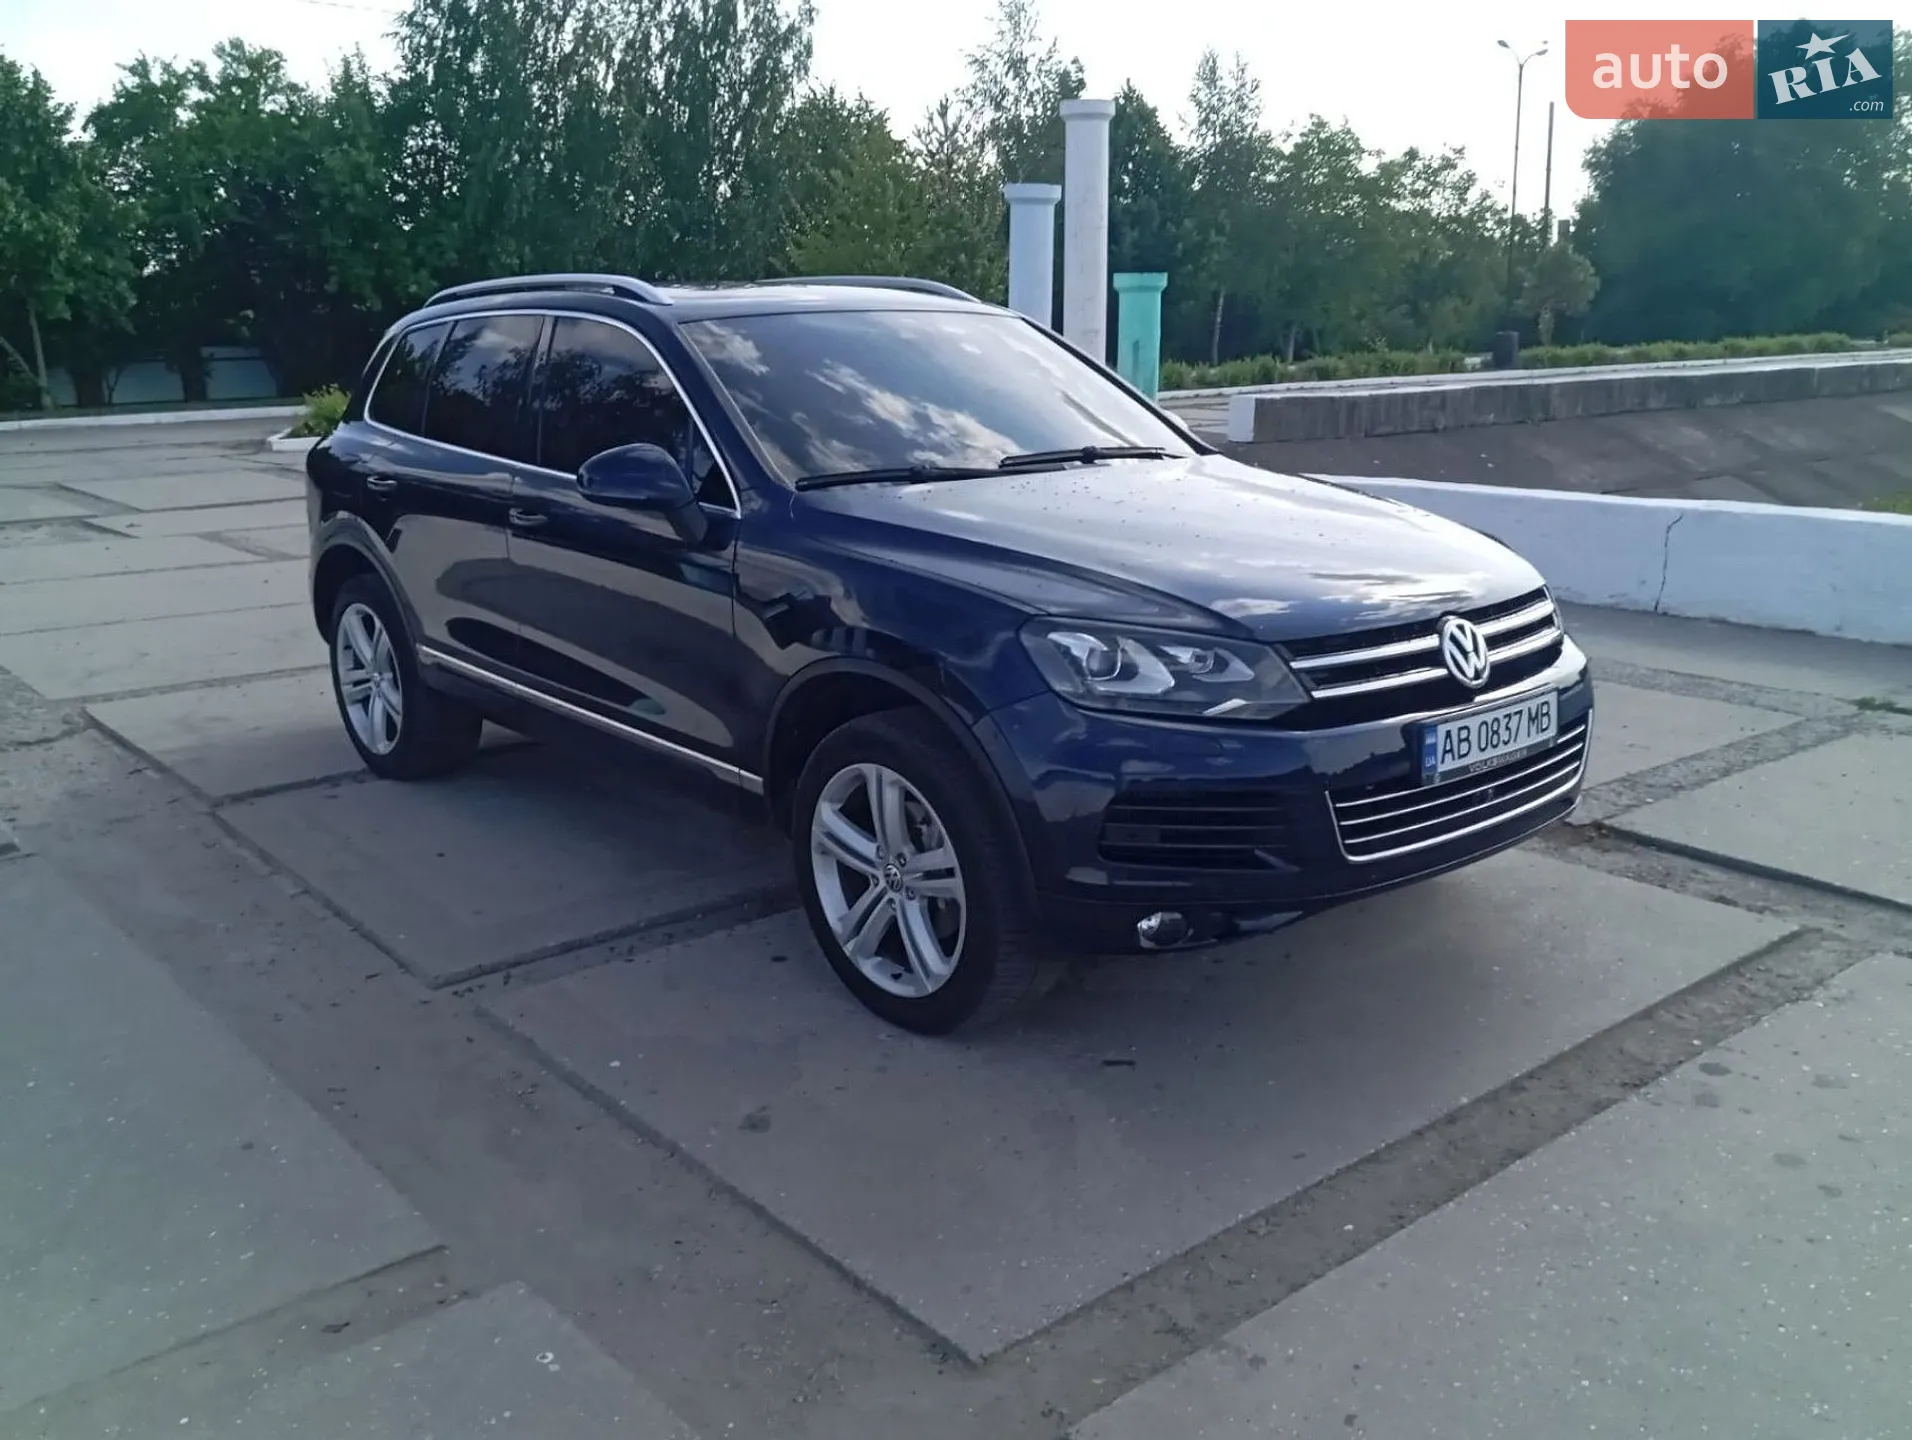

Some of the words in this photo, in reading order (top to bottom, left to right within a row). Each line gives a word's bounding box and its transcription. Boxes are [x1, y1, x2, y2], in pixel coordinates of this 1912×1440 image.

[1441, 726, 1471, 765] AB
[1478, 711, 1524, 752] 0837
[1527, 701, 1550, 737] MB
